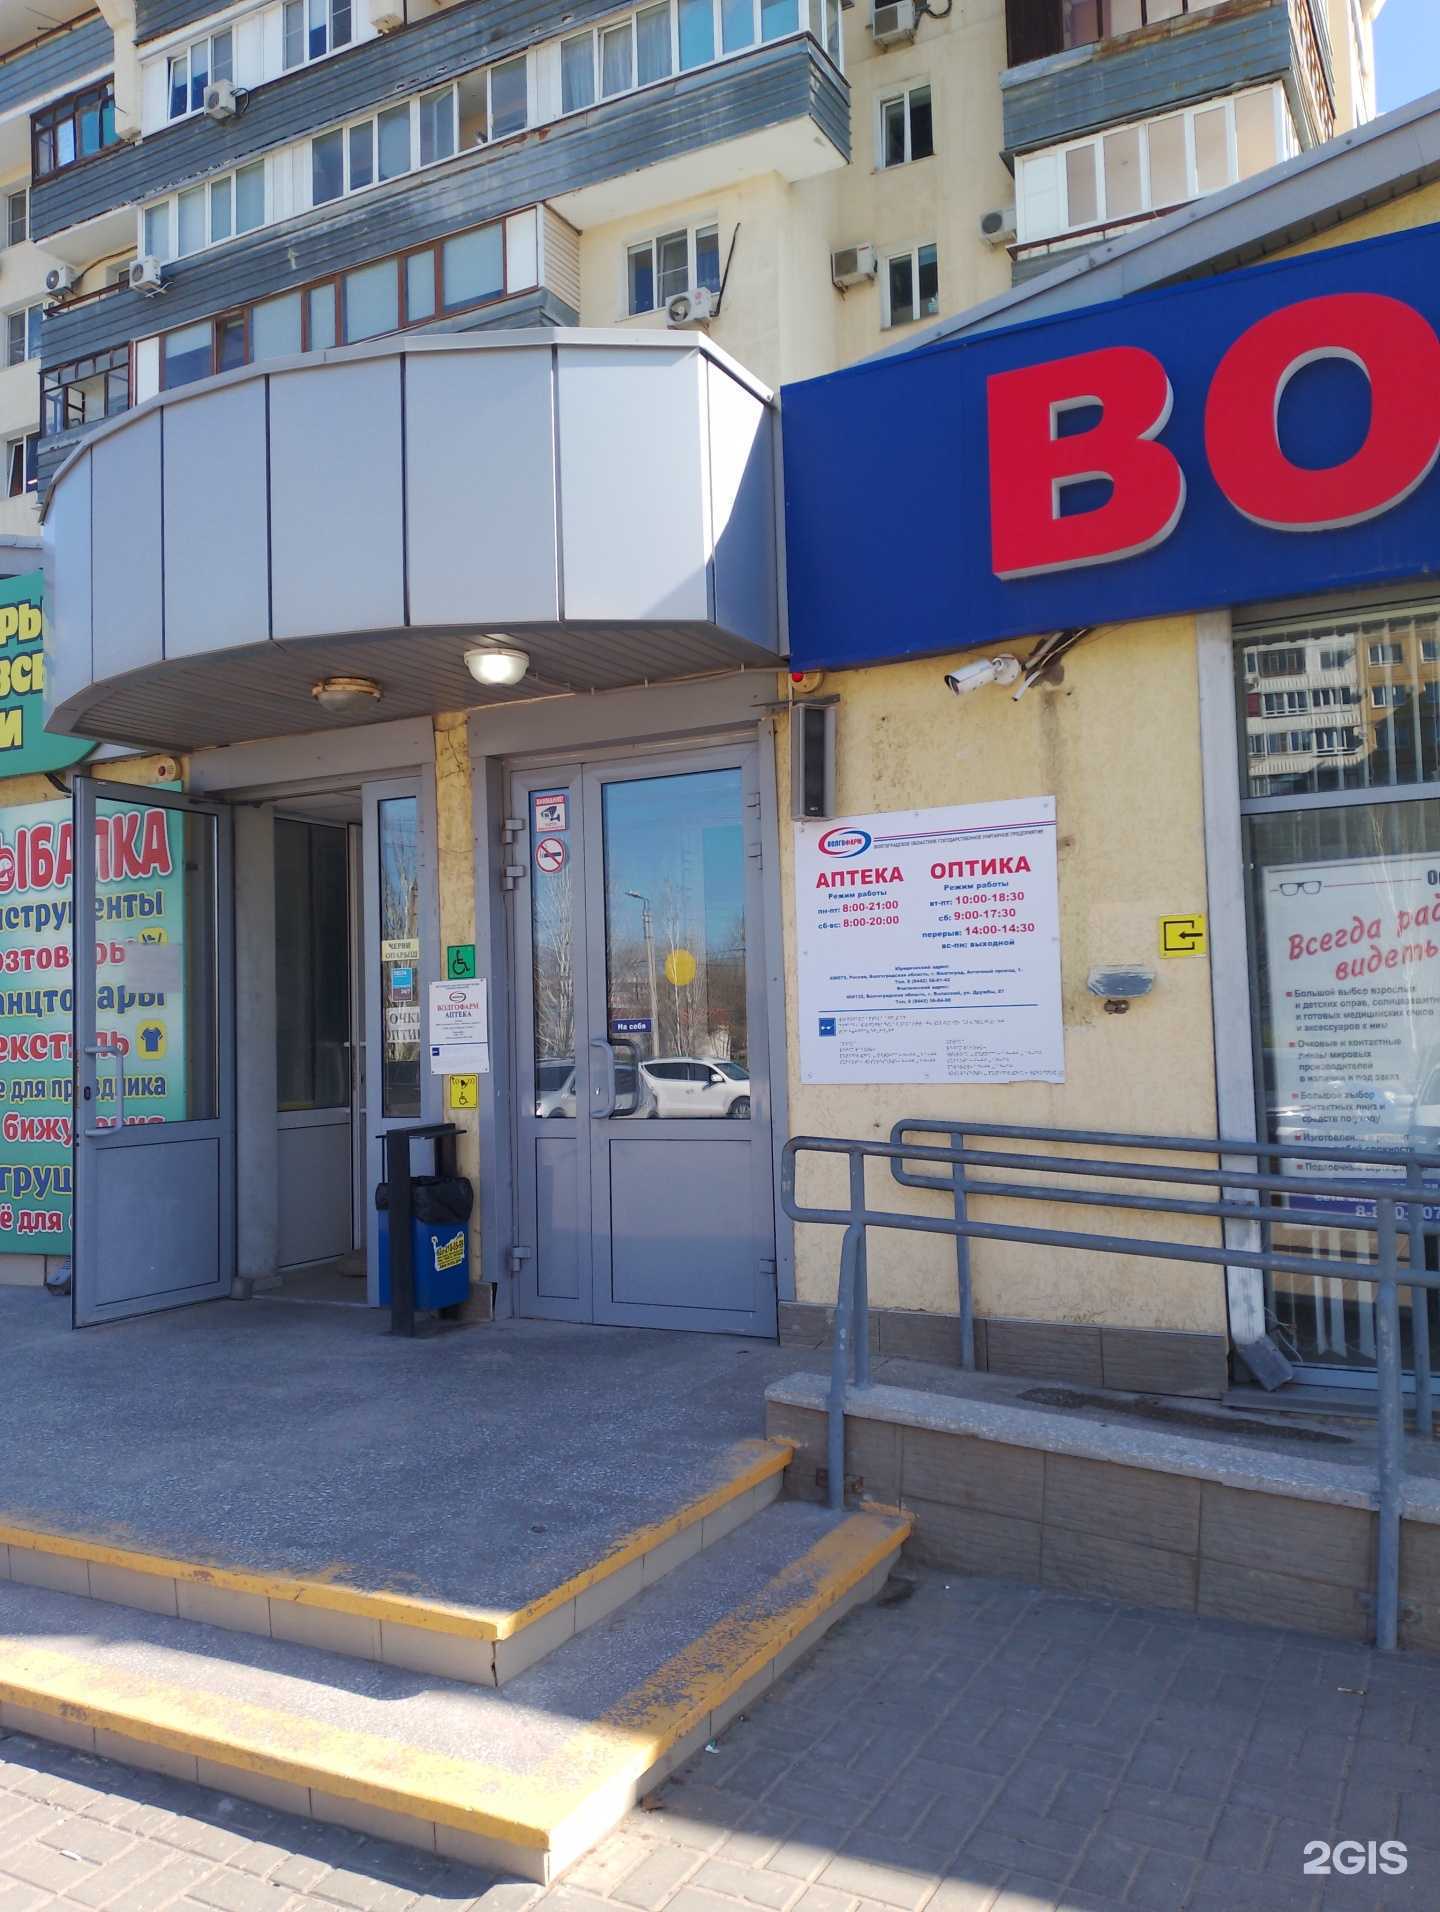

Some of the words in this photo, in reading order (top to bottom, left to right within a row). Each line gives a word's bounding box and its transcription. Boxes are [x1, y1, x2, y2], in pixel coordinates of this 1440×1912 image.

[987, 292, 1440, 582] ВО
[930, 856, 1031, 879] ОПТИКА
[816, 866, 904, 888] АПТЕКА
[976, 881, 1009, 890] работы
[828, 892, 855, 900] Режим
[857, 890, 887, 898] работы
[955, 892, 1025, 905] 10:00-18:30
[842, 900, 899, 912] 8:00-21:00
[843, 915, 899, 928] 8:00-20:00
[938, 914, 951, 922] сб:
[953, 908, 1016, 921] 9:00-17:30
[922, 930, 962, 938] перерыв:
[965, 923, 1035, 935] 14:00-14:30
[970, 939, 1015, 948] выходной
[1288, 915, 1382, 961] Всегда
[1335, 939, 1438, 980] видеть
[629, 1022, 647, 1030] себя
[11, 1079, 46, 1102] для
[18, 1210, 63, 1234] для
